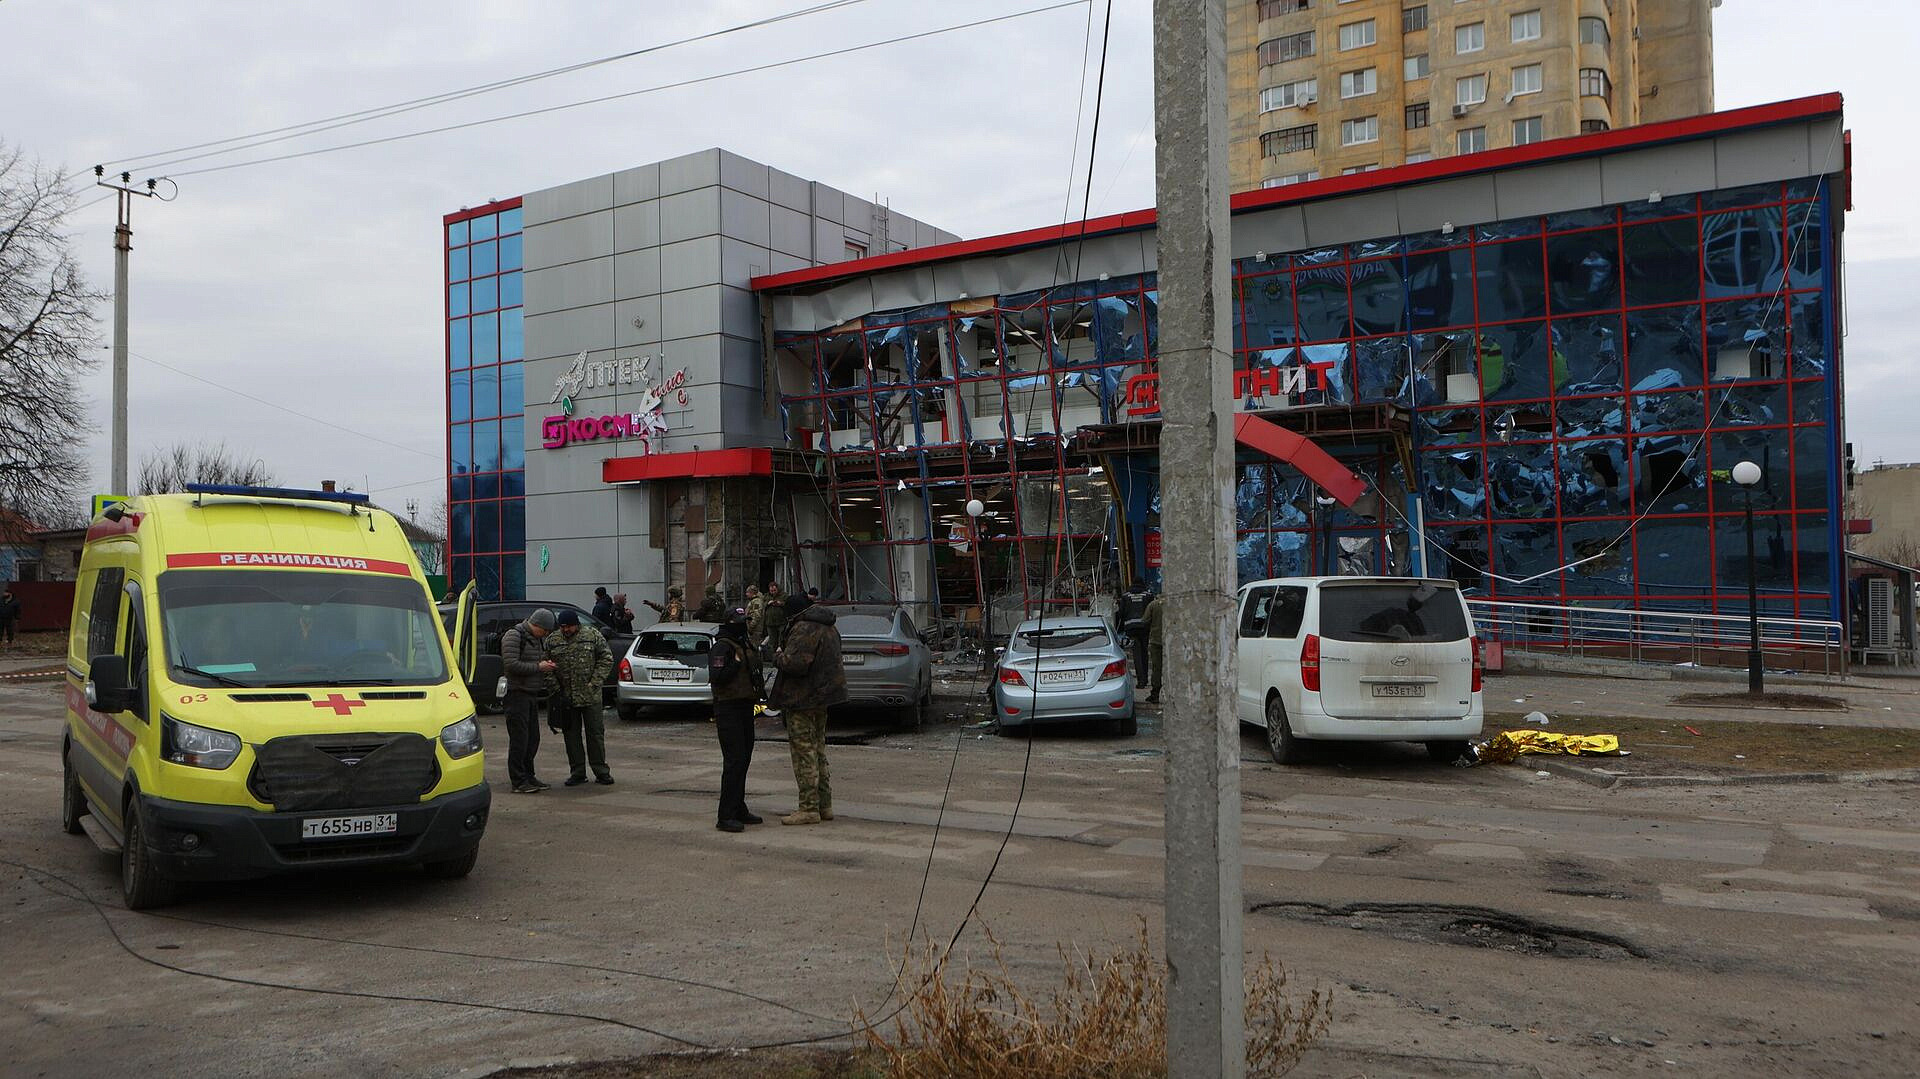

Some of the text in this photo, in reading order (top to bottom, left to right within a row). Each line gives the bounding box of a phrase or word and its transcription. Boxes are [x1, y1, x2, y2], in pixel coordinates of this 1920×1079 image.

[1233, 361, 1335, 399] ГНИТ
[220, 554, 368, 569] РЕАНИМАЦИЯ
[180, 694, 208, 704] 03
[310, 815, 392, 835] Т655НВ 31
